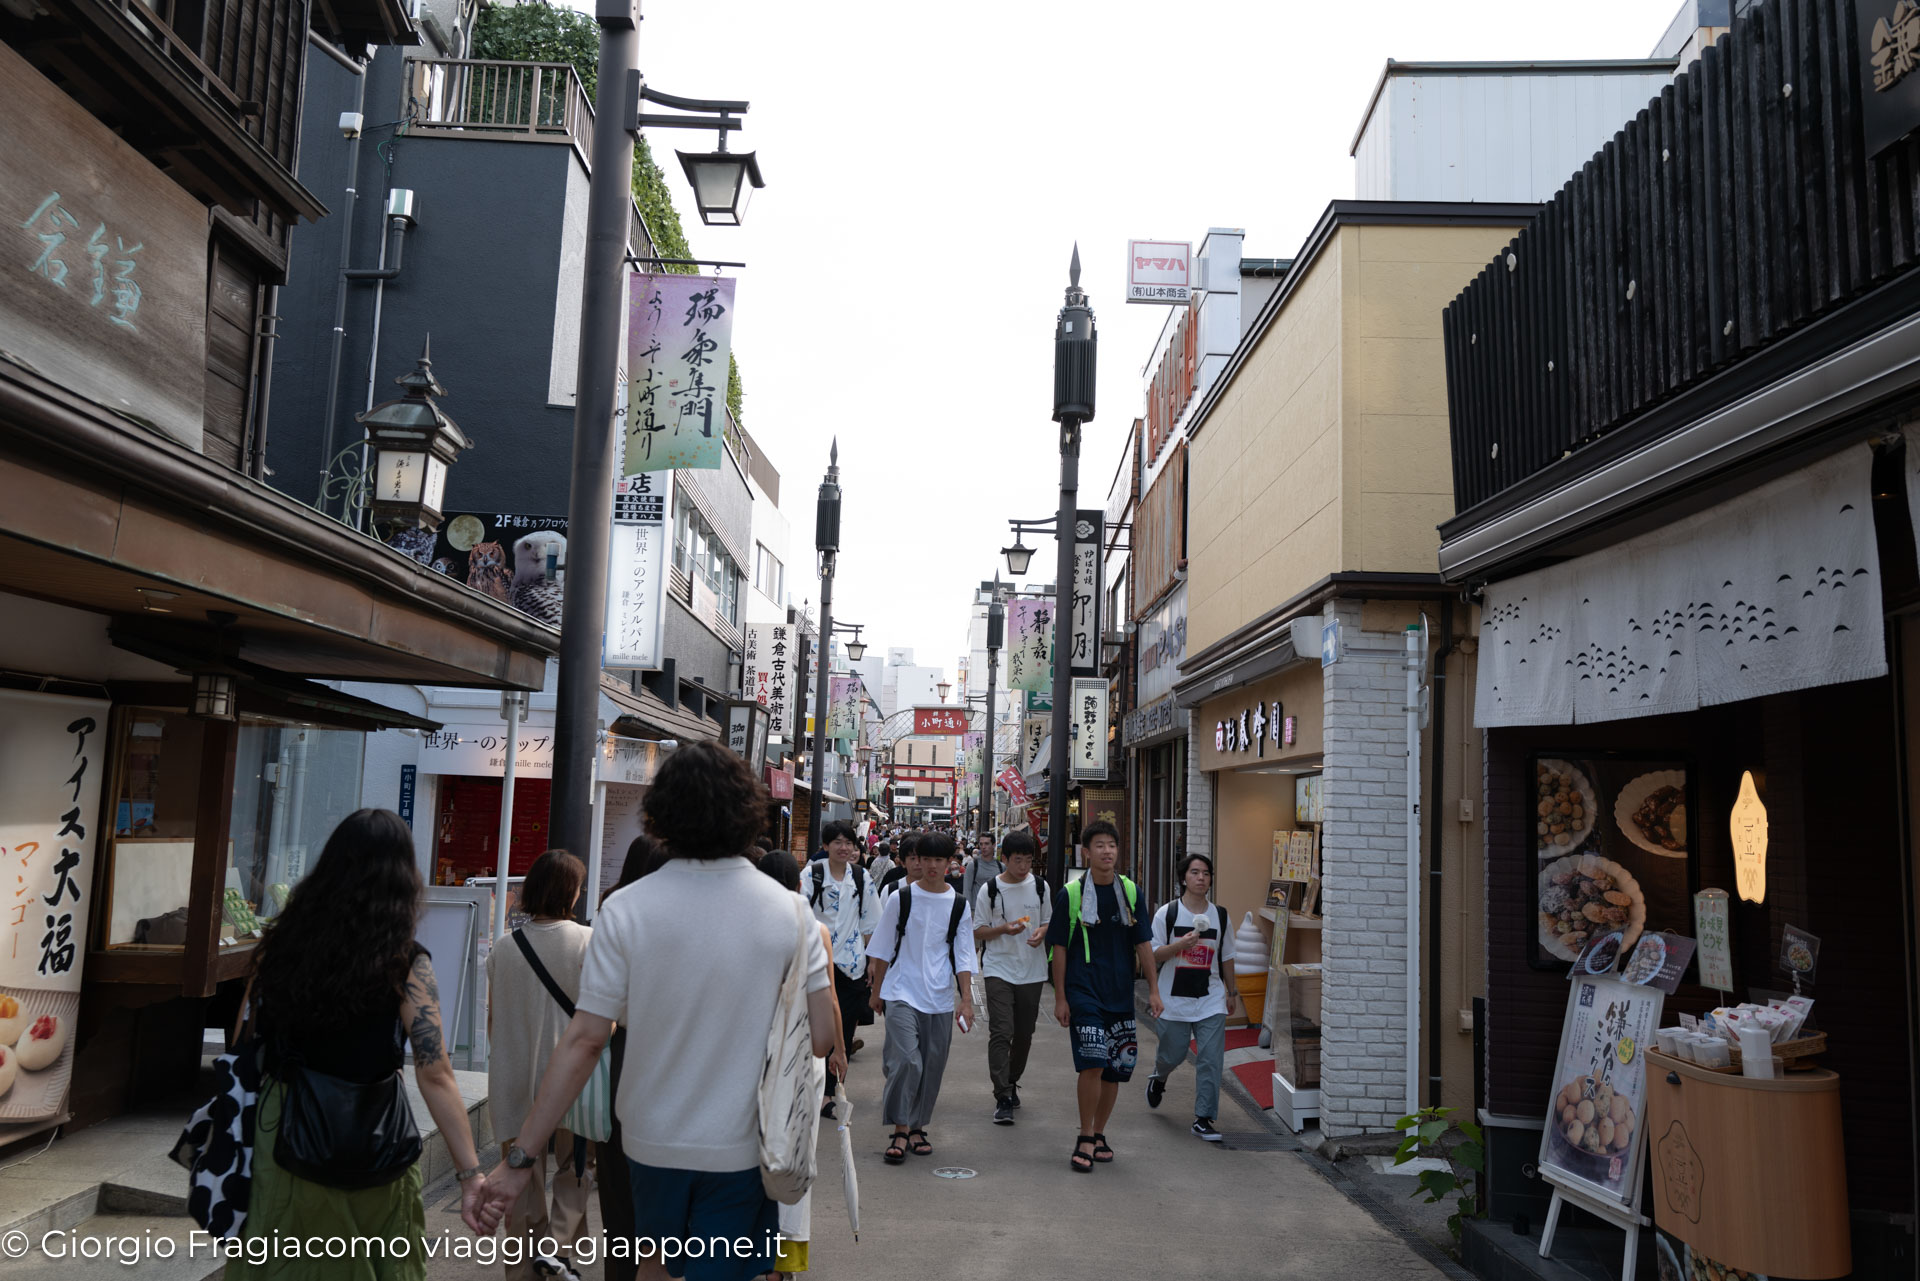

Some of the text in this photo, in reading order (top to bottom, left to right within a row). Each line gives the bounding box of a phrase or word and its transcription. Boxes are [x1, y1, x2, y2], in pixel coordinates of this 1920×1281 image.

[1135, 257, 1186, 272] ヤマハ
[1132, 286, 1187, 299] (有)山本商会
[632, 290, 666, 461] ようこそ小町通り
[495, 514, 512, 528] 2F
[629, 528, 649, 652] 世界一のアップルパイ
[612, 652, 649, 661] mille mele
[744, 628, 758, 697] 古美術 茶道具
[756, 671, 769, 706] 買入処
[769, 626, 788, 732] 鎌倉古代美術店
[921, 717, 962, 729] 小町通り
[424, 731, 554, 753] 世界一のアップ
[38, 716, 97, 976] アイス大福
[11, 841, 40, 960] マンゴー
[1699, 915, 1724, 933] お味見
[1702, 934, 1724, 952] どうぞ
[1583, 1020, 1604, 1099] ミックス
